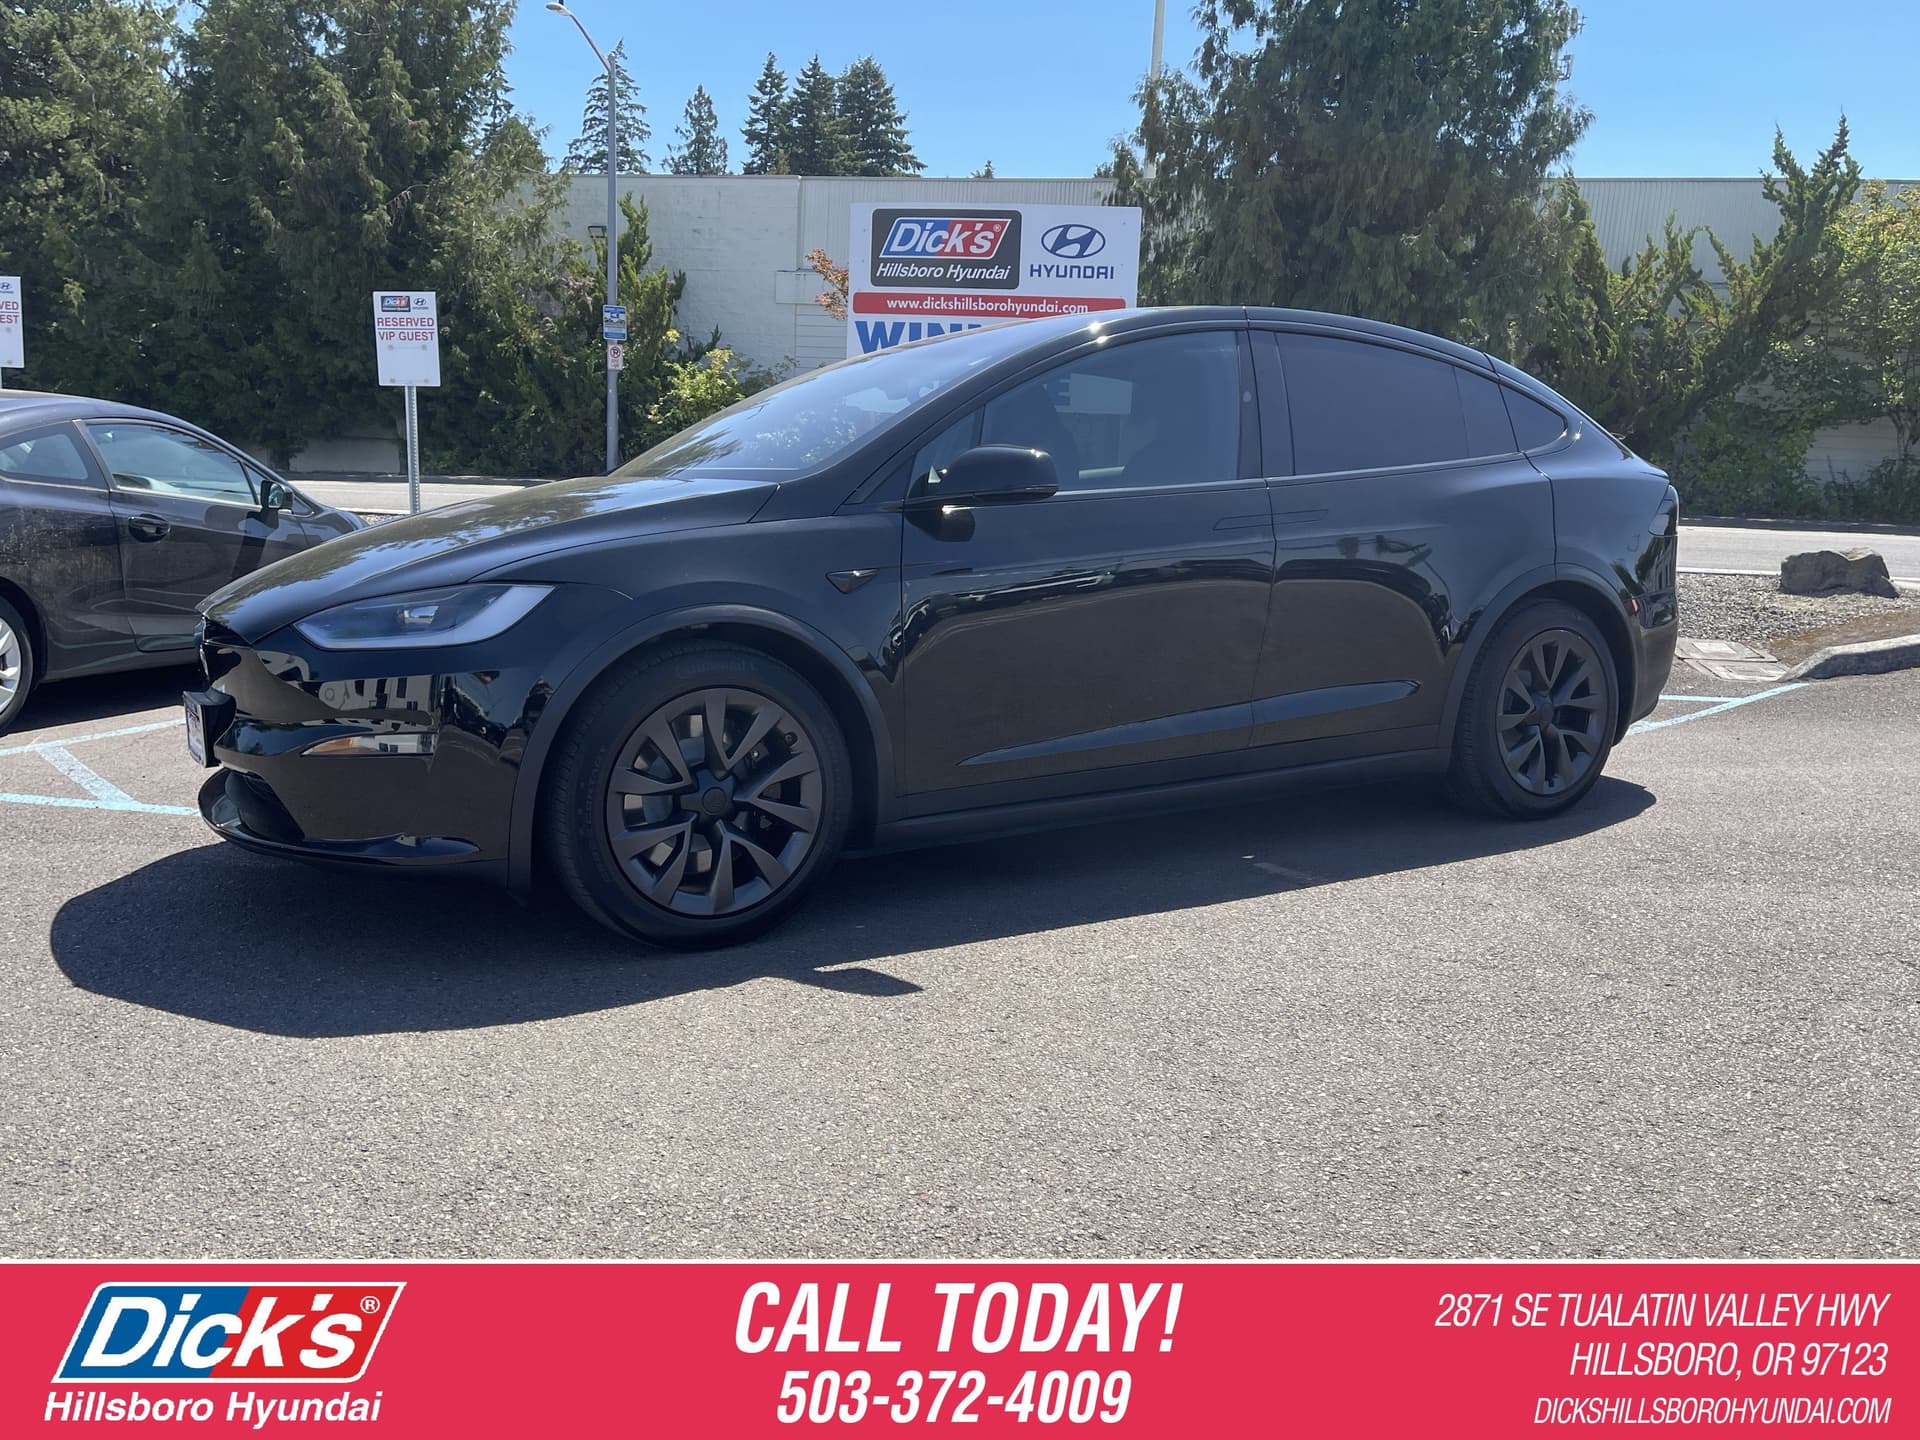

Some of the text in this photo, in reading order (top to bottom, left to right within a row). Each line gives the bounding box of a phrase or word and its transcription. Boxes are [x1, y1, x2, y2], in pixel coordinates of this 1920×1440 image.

[876, 262, 1012, 282] Hillsboro Hyundai
[1029, 263, 1115, 280] HYUNDAI
[886, 296, 1089, 316] www.dickshillsborohyundai.com
[377, 317, 435, 327] RESERVED
[378, 331, 436, 341] VIP GUEST
